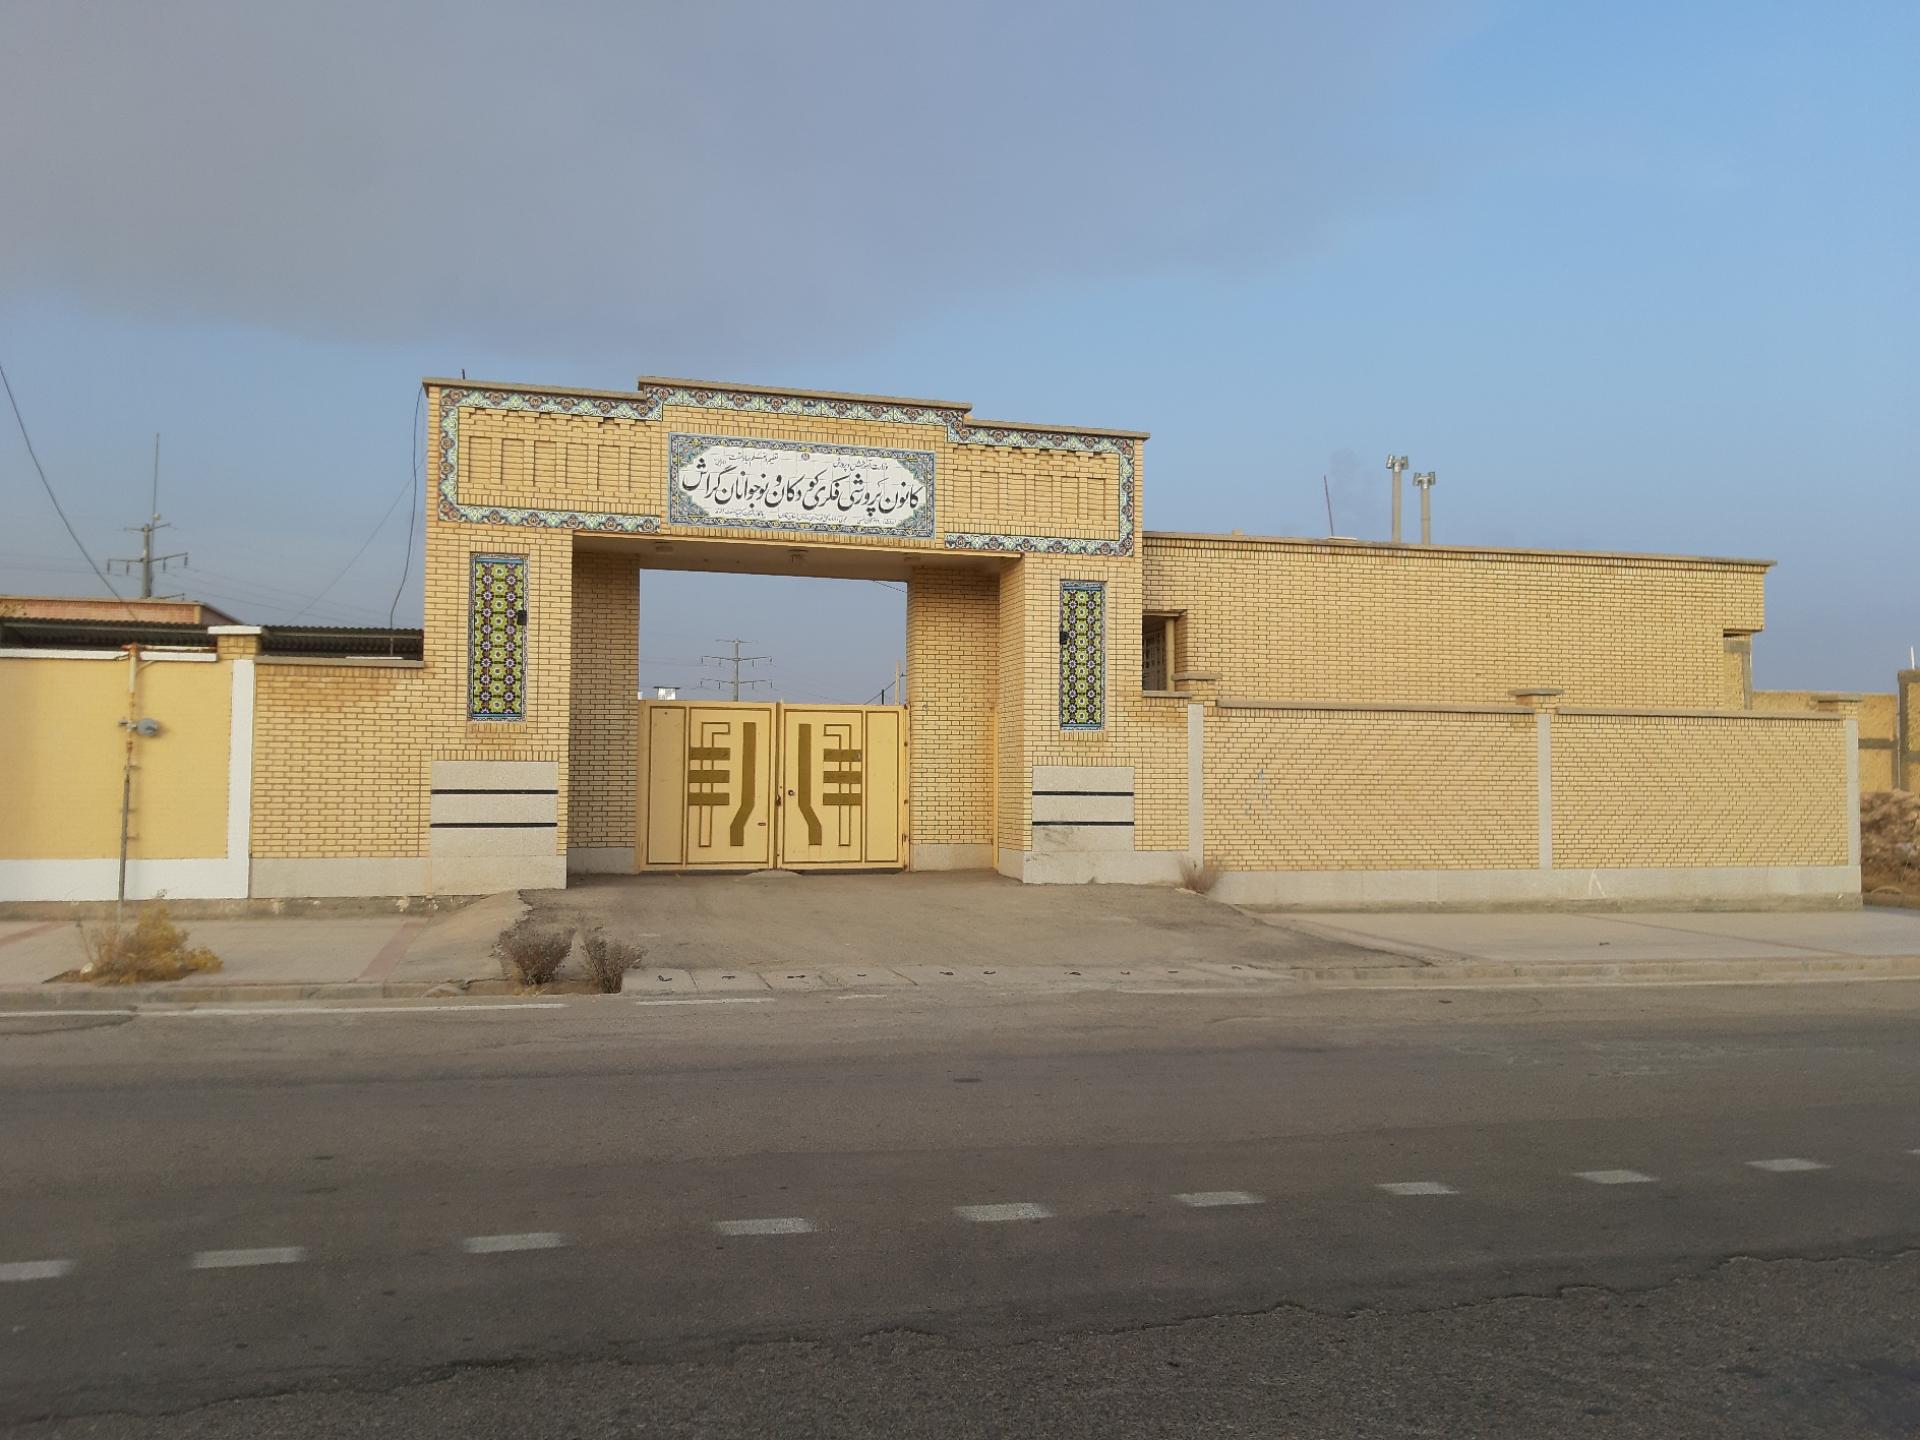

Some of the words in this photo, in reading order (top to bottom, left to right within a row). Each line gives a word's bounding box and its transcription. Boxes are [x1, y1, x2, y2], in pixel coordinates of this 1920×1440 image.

[682, 457, 738, 499] گراش
[714, 470, 770, 509] نوجوانان
[764, 468, 828, 508] کودکان
[802, 473, 851, 511] فکری
[837, 473, 884, 517] پرورشی
[878, 481, 924, 514] کانون
